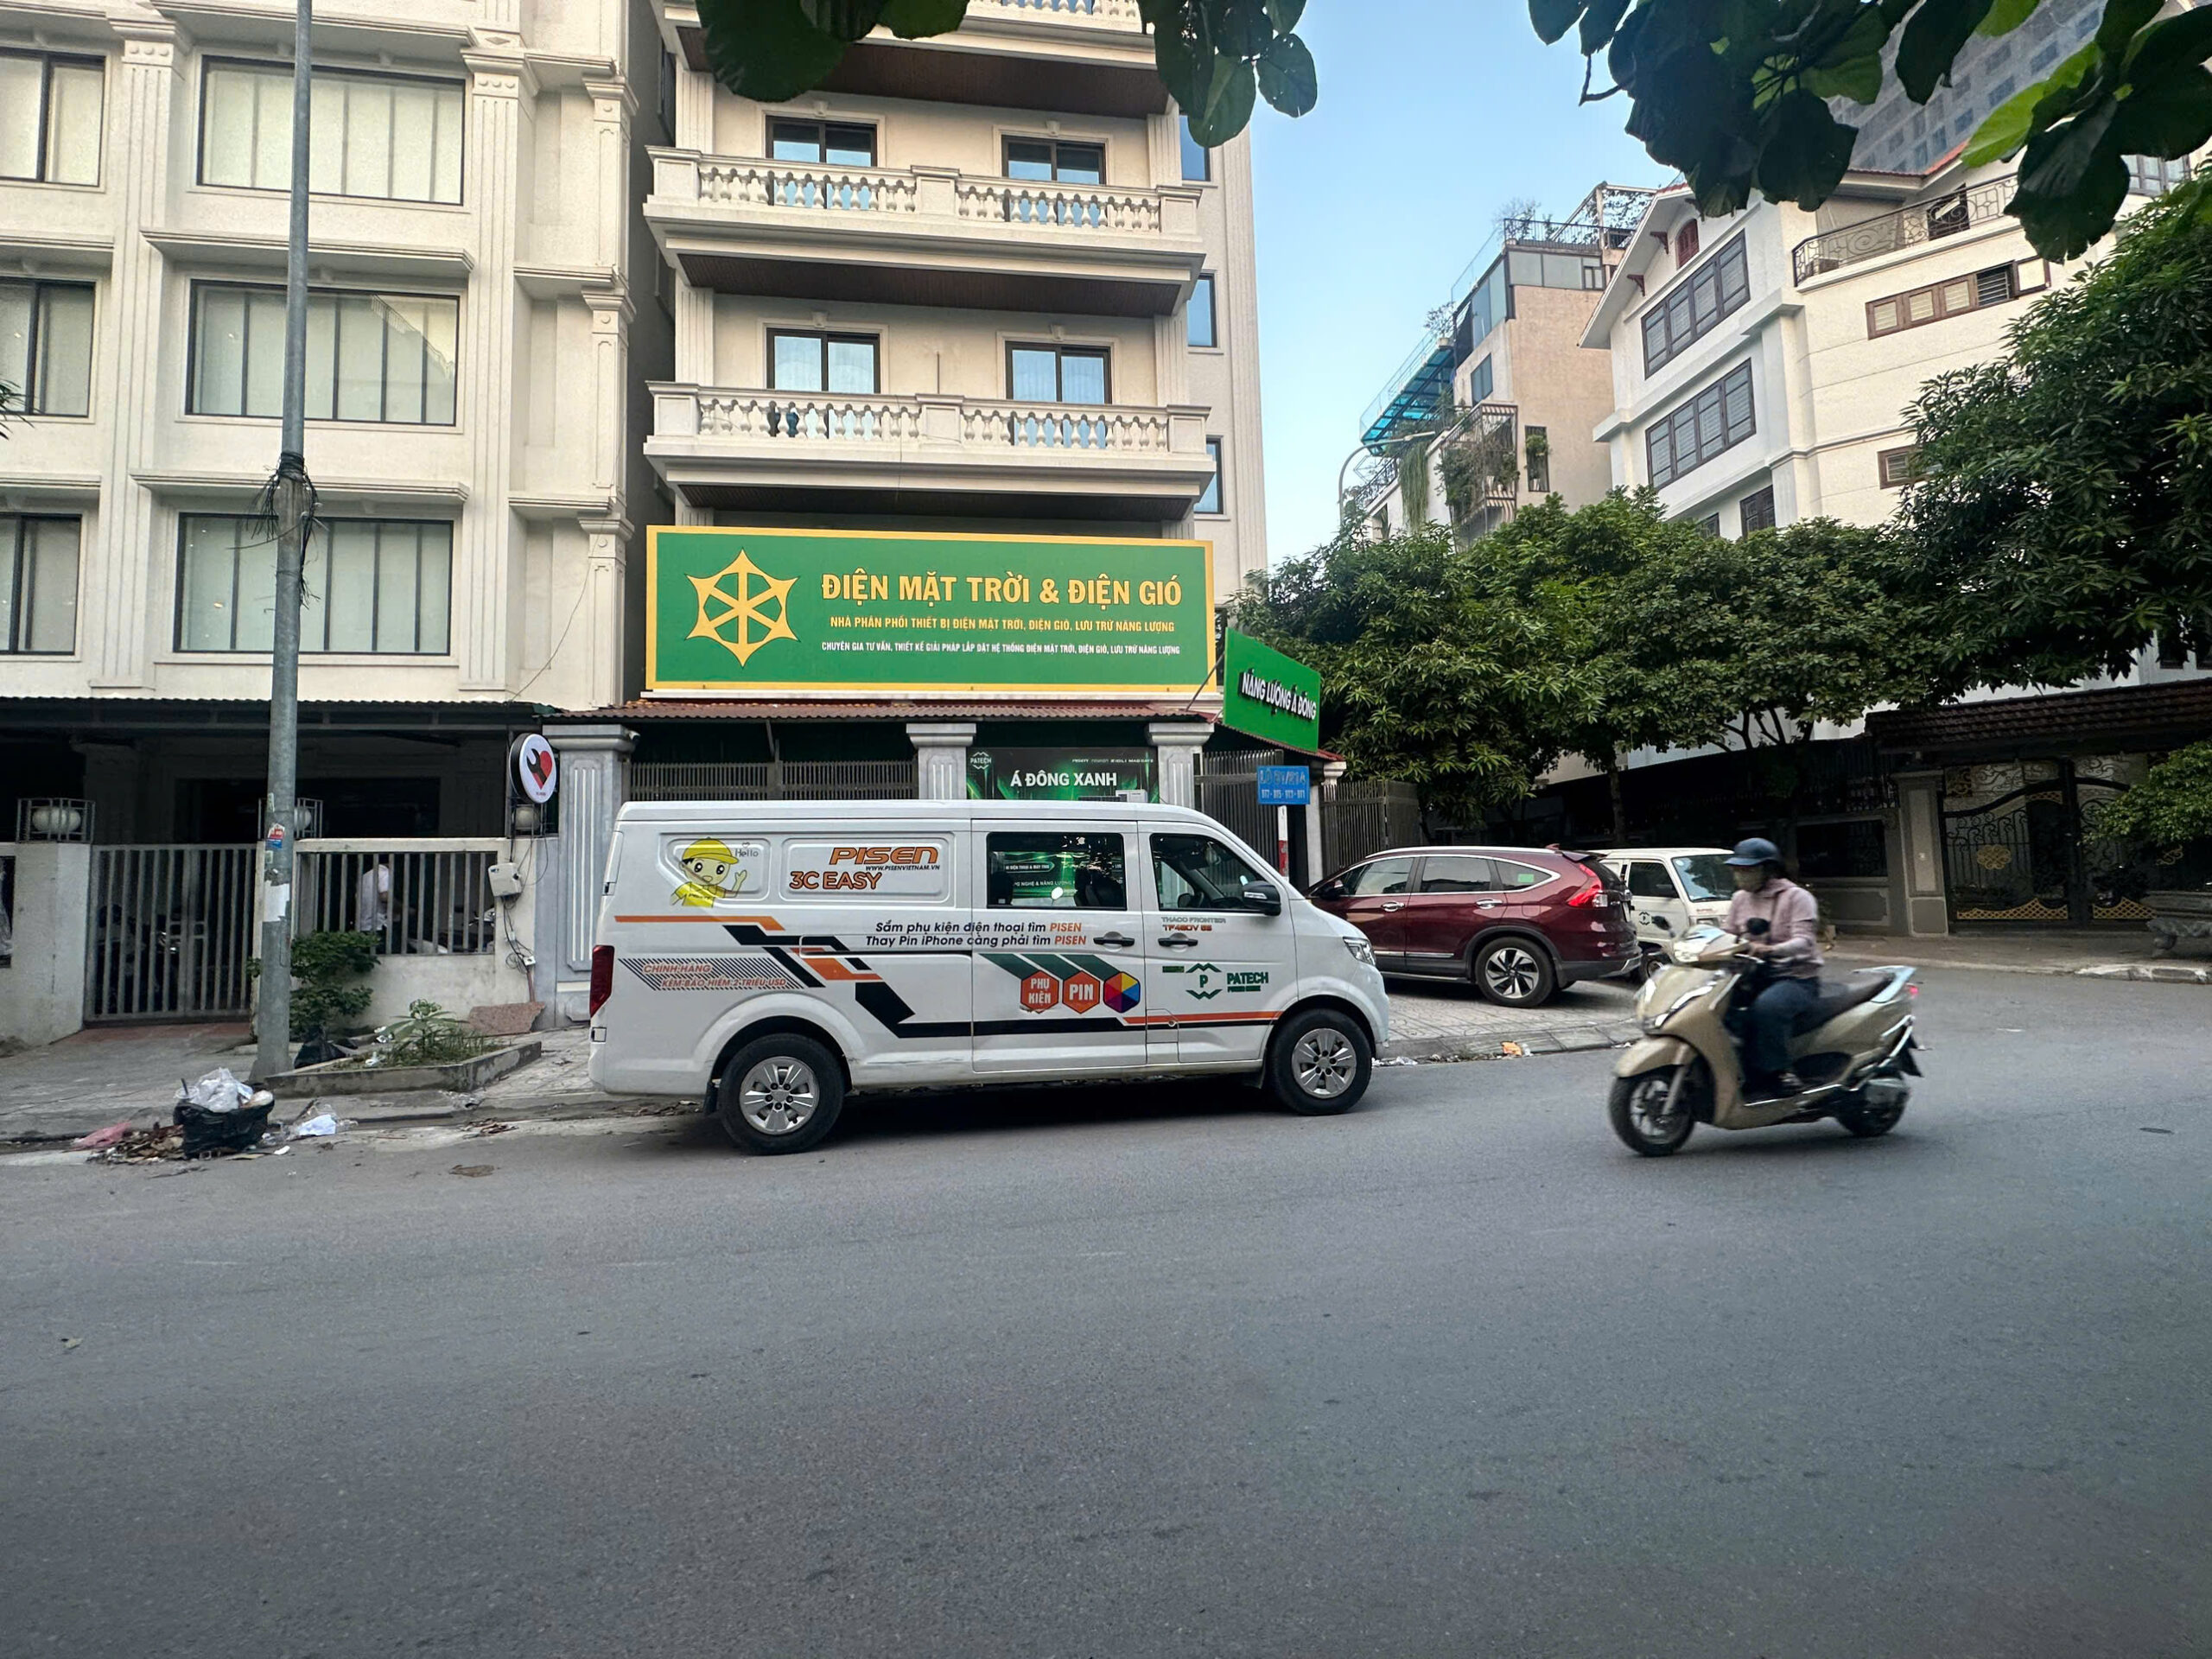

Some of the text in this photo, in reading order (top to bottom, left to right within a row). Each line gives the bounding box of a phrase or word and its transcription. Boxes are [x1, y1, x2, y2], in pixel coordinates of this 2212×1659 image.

[821, 567, 1183, 611] ĐIỆN MẶT TRỜI & ĐIỆN GIÓ
[830, 615, 852, 628] NHÀ
[855, 615, 882, 628] PHÂN
[885, 614, 908, 628] PHỐI
[911, 616, 938, 629] THIẾT
[940, 618, 950, 631] BỊ
[952, 617, 976, 632] ĐIỆN
[978, 618, 999, 632] MẶT
[1002, 618, 1027, 631] TRỜI,
[1028, 619, 1051, 632] ĐIỆN
[1075, 620, 1093, 632] LƯU
[1116, 619, 1141, 632] NĂNG
[1144, 620, 1174, 634] LƯỢNG
[822, 640, 850, 652] CHUYÊN
[852, 642, 864, 652] GIA
[866, 641, 876, 652] TƯ
[894, 640, 914, 652] THIẾT
[915, 641, 925, 652] KẾ
[1026, 643, 1042, 654] ĐIỆN
[1078, 644, 1094, 655] ĐIỆN
[1159, 645, 1180, 655] LƯỢNG
[1241, 668, 1317, 721] NĂNG LƯỢNG Á ĐÔNG
[1010, 769, 1117, 787] Á ĐÔNG XANH
[734, 849, 759, 857] Hello
[829, 846, 939, 865] PISEN
[789, 871, 882, 890] 3C EASY
[875, 920, 1082, 935] Sắm phụ kiện điện thoại tìm PISEN
[866, 934, 1087, 948] Thay Pin iPhone càng phải tìm PISEN
[643, 963, 678, 974] CHÍNH
[733, 978, 739, 987] 2
[741, 977, 766, 988] TRIỆU
[767, 978, 787, 987] USD
[1030, 978, 1050, 991] PHỤ
[1199, 975, 1208, 988] P
[1226, 972, 1268, 985] PATECH
[1028, 991, 1052, 1007] KIỆN
[1069, 983, 1094, 1001] PIN
